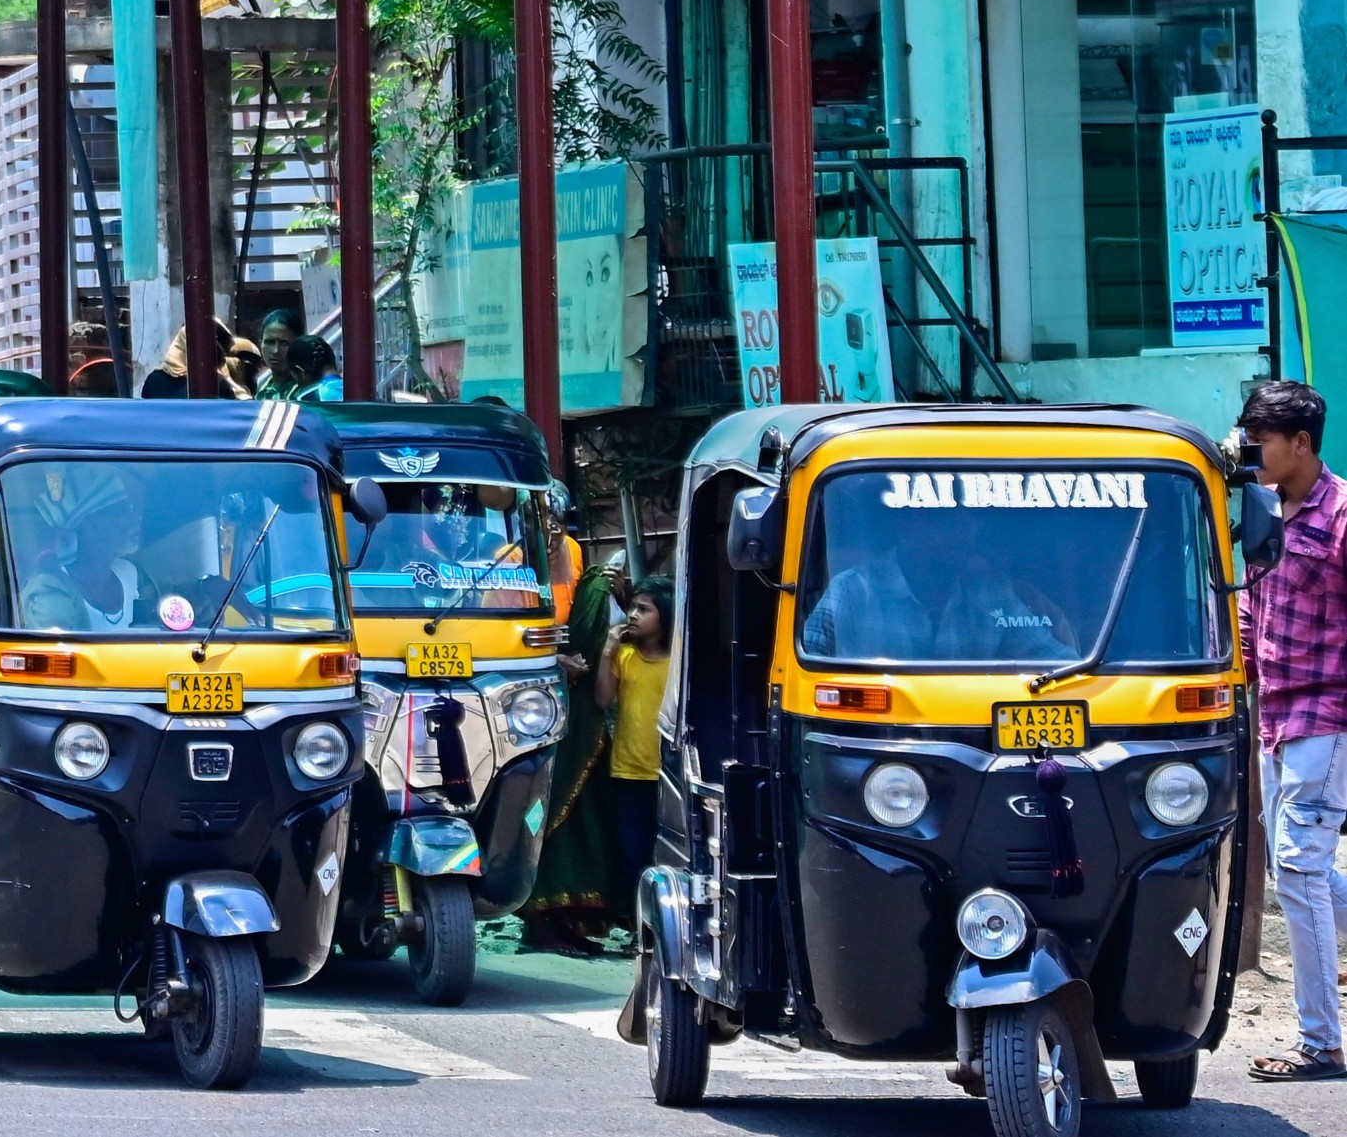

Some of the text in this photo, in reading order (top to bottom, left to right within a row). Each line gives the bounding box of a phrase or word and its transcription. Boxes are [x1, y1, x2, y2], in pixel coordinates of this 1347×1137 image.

[584, 184, 619, 232] CLINIC
[1173, 169, 1243, 232] ROYAL
[882, 473, 1148, 509] JAI BHAVANI
[995, 615, 1054, 628] AMMA
[422, 645, 459, 660] KA32
[419, 661, 465, 676] C8579
[181, 676, 233, 692] KA32A
[182, 694, 234, 710] A2325
[1012, 707, 1074, 727] KA32A
[1014, 728, 1075, 747] A6833
[322, 868, 337, 880] CNG
[1181, 927, 1202, 940] CNG
